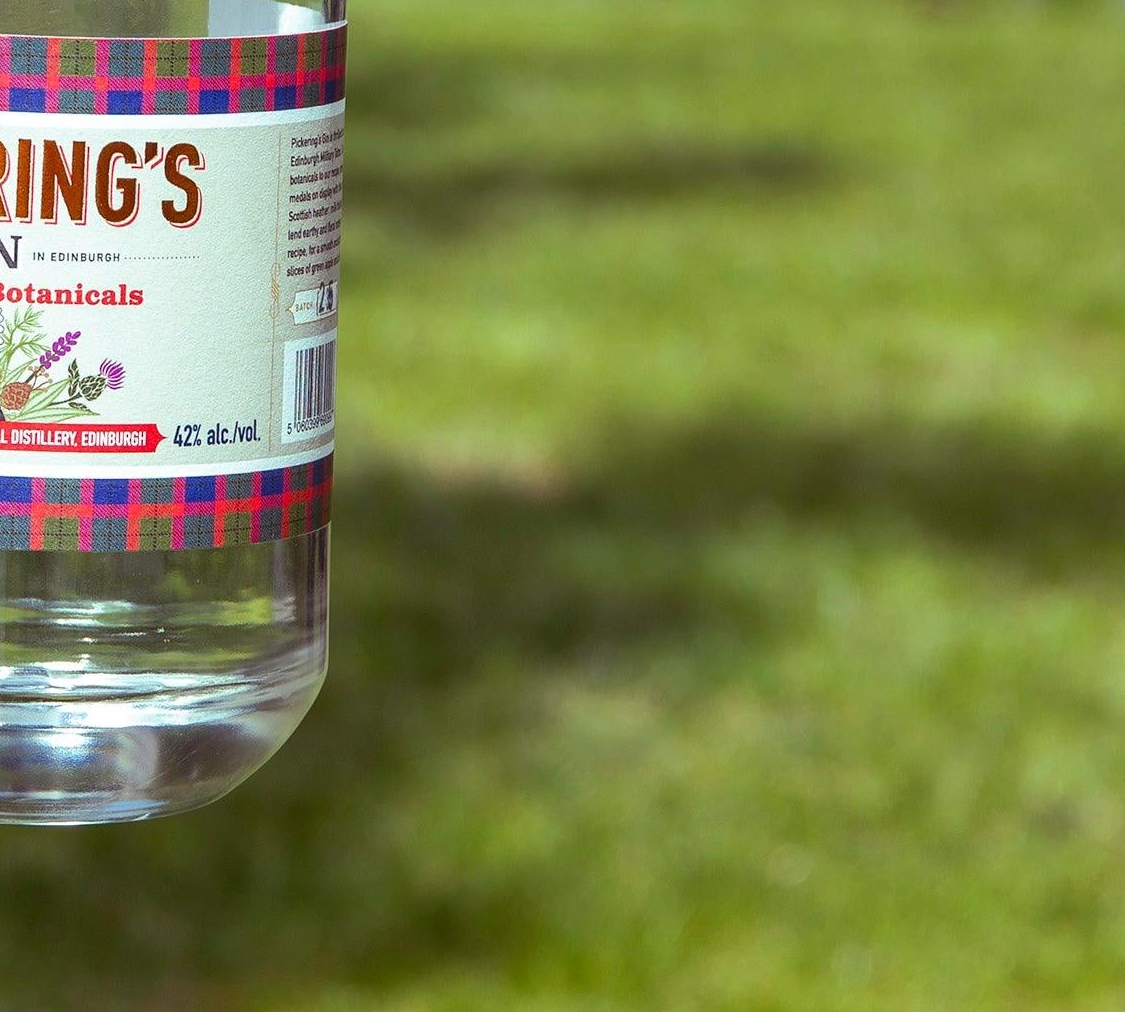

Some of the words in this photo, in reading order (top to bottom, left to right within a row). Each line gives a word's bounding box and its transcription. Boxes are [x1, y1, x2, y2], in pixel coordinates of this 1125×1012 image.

[290, 134, 321, 149] Pickering's
[290, 152, 320, 167] Edinburgh
[289, 171, 319, 186] botanicals
[289, 190, 312, 204] medals
[288, 208, 312, 223] Scottish
[287, 228, 302, 241] lend
[302, 226, 319, 239] earthy
[32, 251, 45, 262] IN
[50, 252, 121, 263] EDINBURGH
[308, 244, 316, 256] for
[286, 265, 305, 278] slices
[305, 262, 311, 275] of
[311, 261, 324, 276] green
[173, 423, 202, 447] 42%
[206, 419, 261, 446] alc./vol.
[286, 422, 293, 435] 5
[11, 430, 78, 447] DISTILLERY,
[81, 430, 147, 447] EDINBURGH
